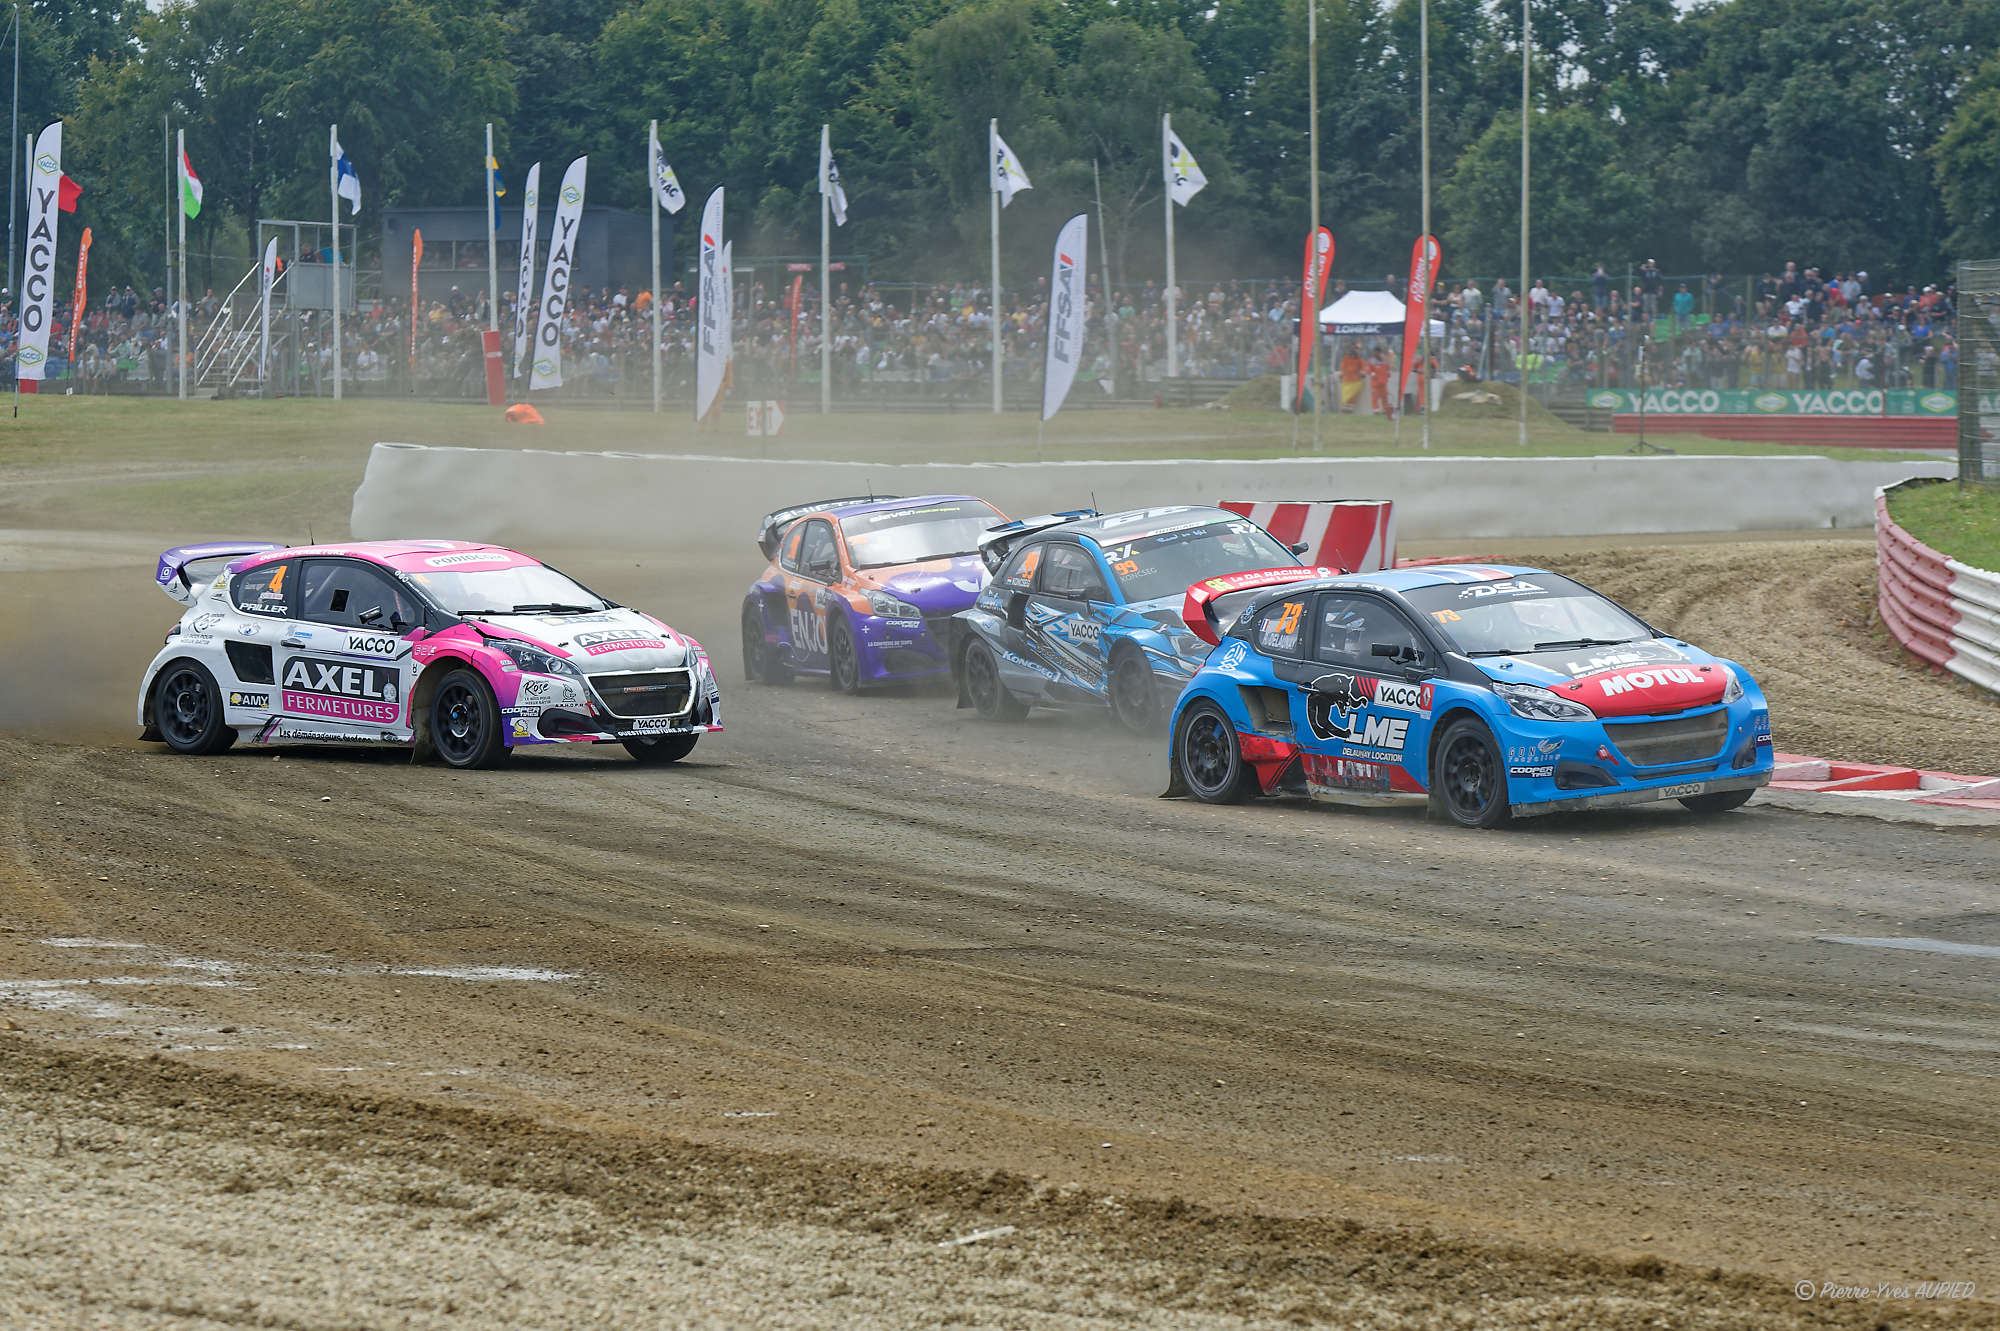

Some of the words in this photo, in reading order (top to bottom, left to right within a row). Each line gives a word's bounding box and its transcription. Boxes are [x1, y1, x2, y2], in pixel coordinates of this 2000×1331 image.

[24, 187, 56, 332] YACCO
[542, 216, 575, 347] YACCO
[1054, 257, 1076, 364] FFSA
[1627, 390, 1720, 413] YACCO
[1792, 390, 1884, 413] YACCO
[268, 565, 288, 593] 4
[1113, 560, 1139, 576] 99
[1244, 573, 1262, 581] DA
[1264, 569, 1312, 578] RACING
[1275, 602, 1303, 635] 73
[1430, 609, 1462, 624] 73
[348, 636, 396, 654] YACCO
[590, 640, 665, 654] FERMETURES
[284, 661, 382, 698] AXEL
[523, 680, 550, 696] Rose
[1599, 668, 1705, 697] MOTUL
[287, 694, 394, 720] FERMETURES
[637, 720, 667, 729] YACCO
[1346, 712, 1409, 750] LME
[1371, 750, 1403, 762] LOCATION
[1510, 766, 1553, 774] COOPER
[1663, 783, 1701, 797] YACCO
